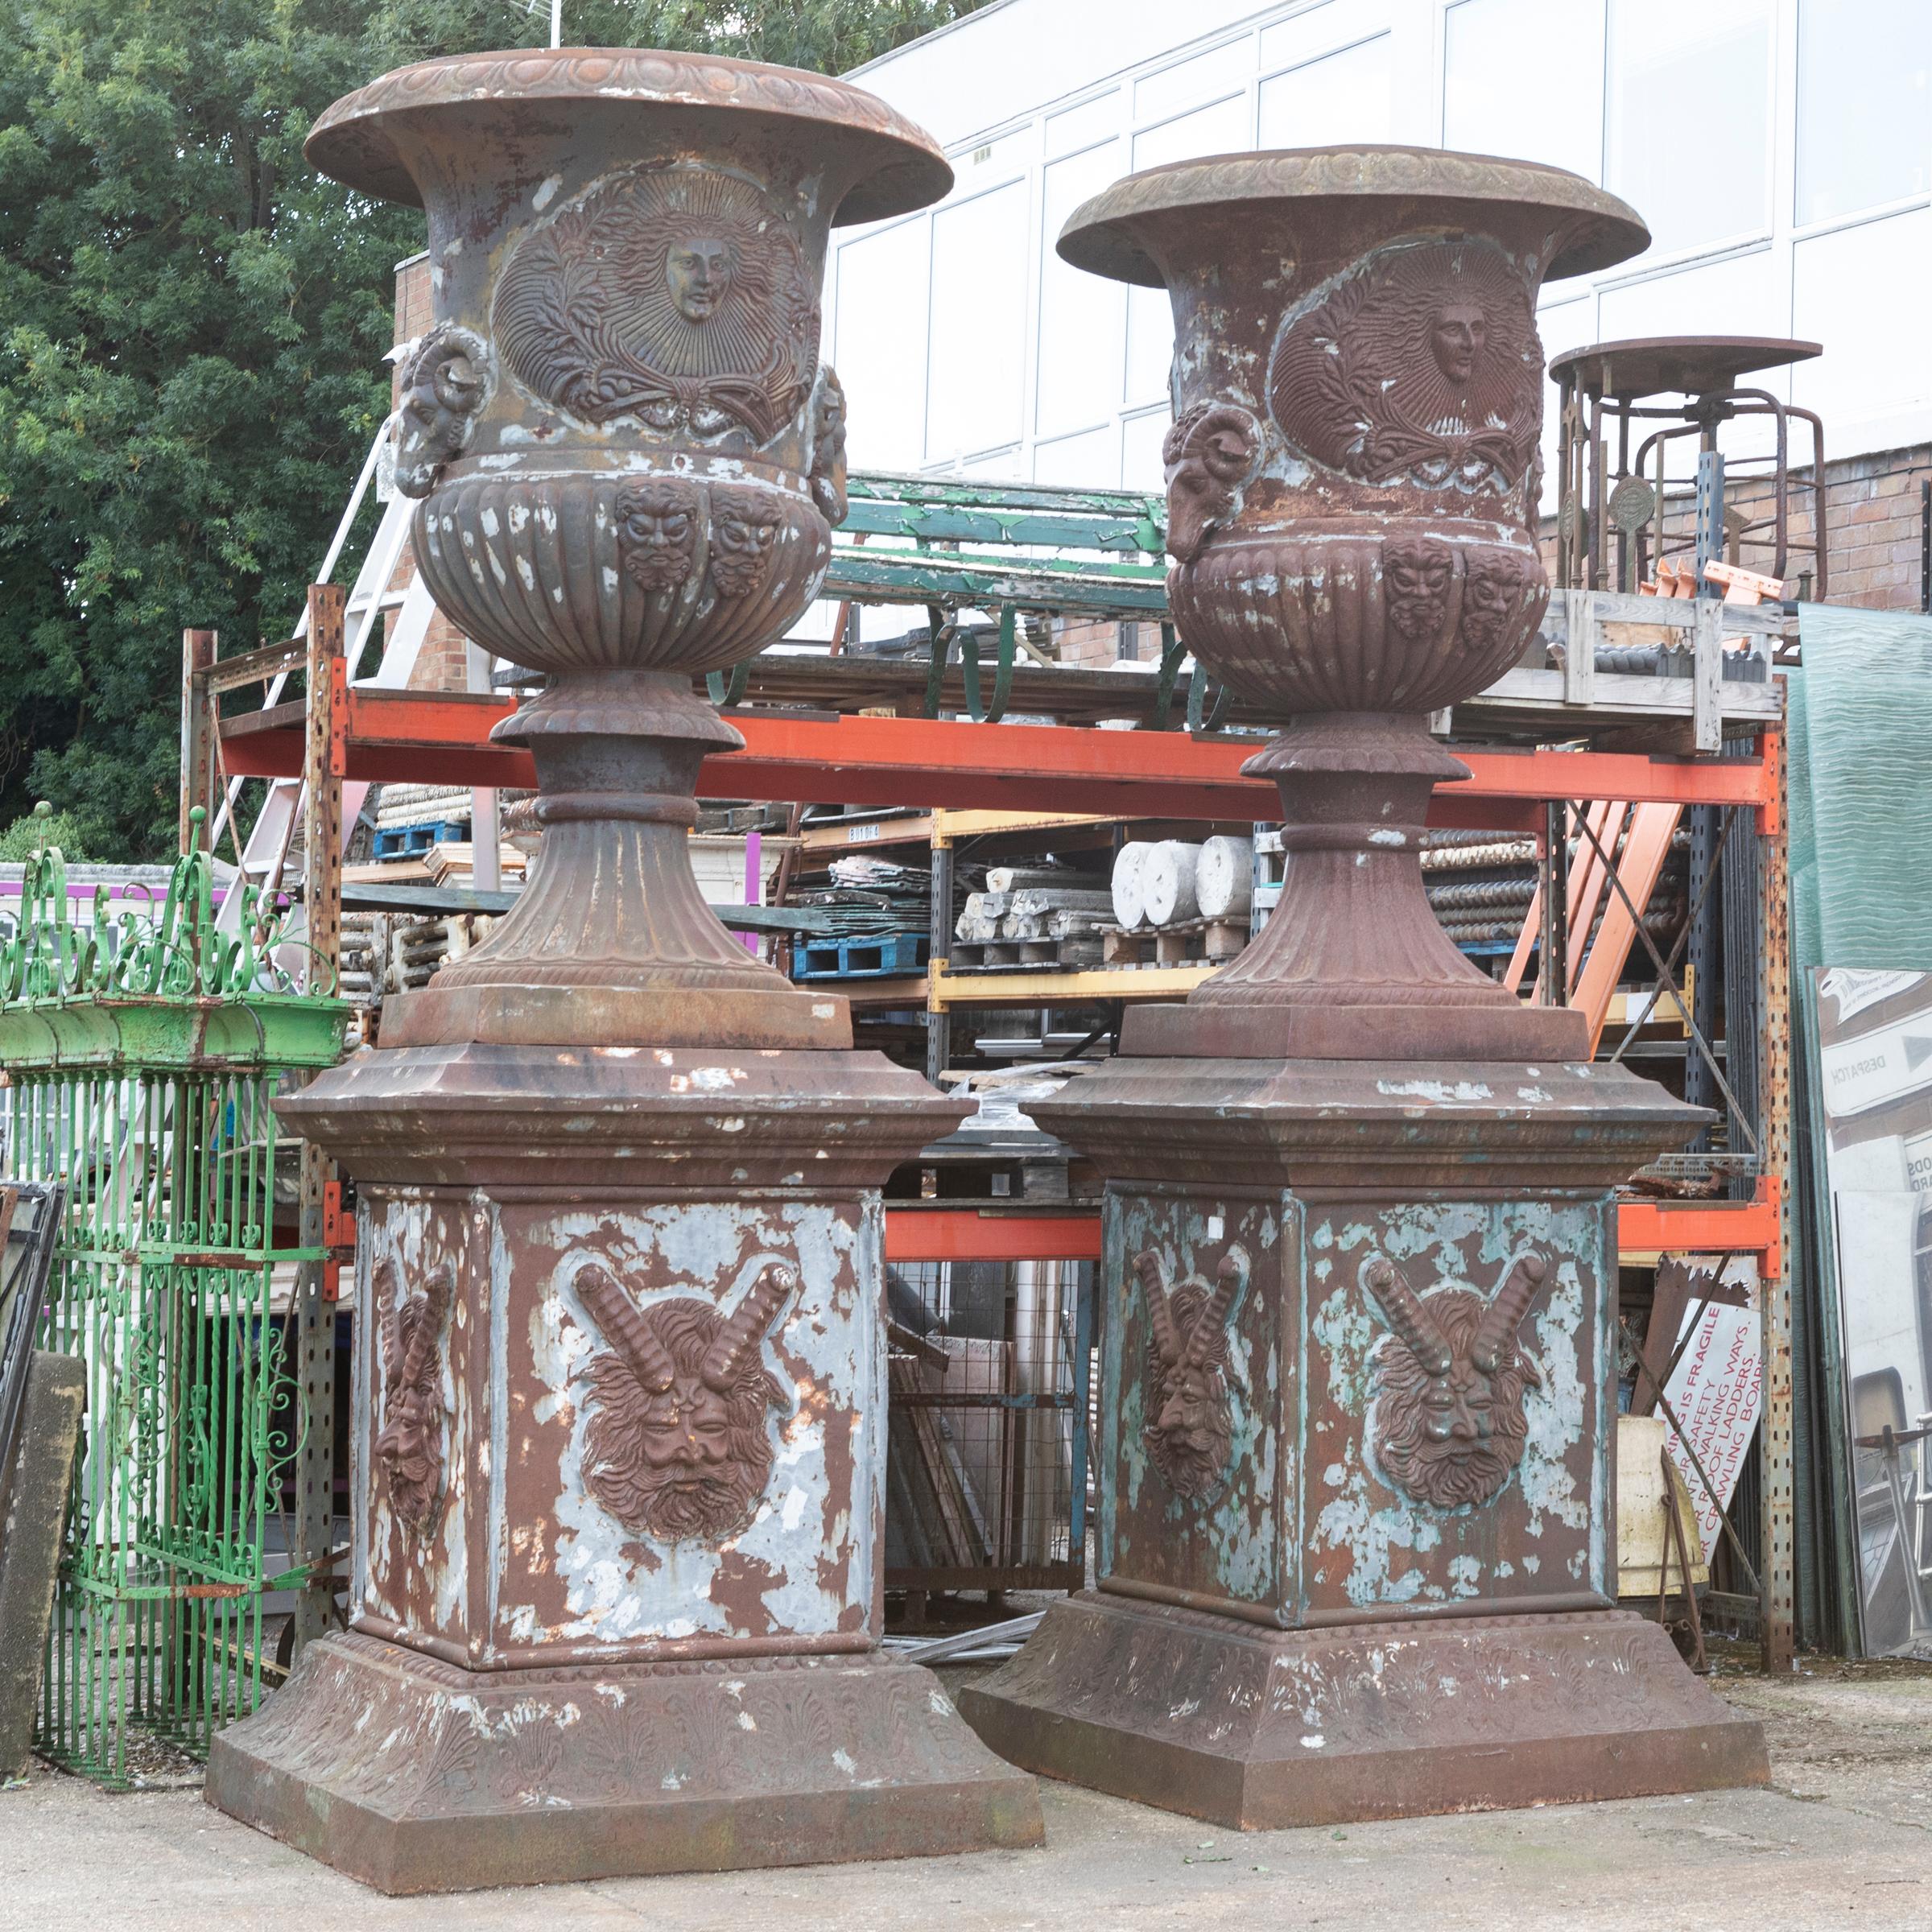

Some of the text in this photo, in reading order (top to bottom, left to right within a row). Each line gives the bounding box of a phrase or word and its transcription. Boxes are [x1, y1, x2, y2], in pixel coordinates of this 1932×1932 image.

[1686, 1307, 1720, 1386] FRAGILE
[1680, 1392, 1693, 1407] IS
[1689, 1378, 1715, 1448] SAFETY
[1697, 1384, 1730, 1465] WALKING
[1724, 1321, 1751, 1376] WAYS.
[1698, 1445, 1724, 1502] ROOF
[1719, 1353, 1757, 1440] LADDERS.
[1705, 1431, 1745, 1531] CRAWLING
